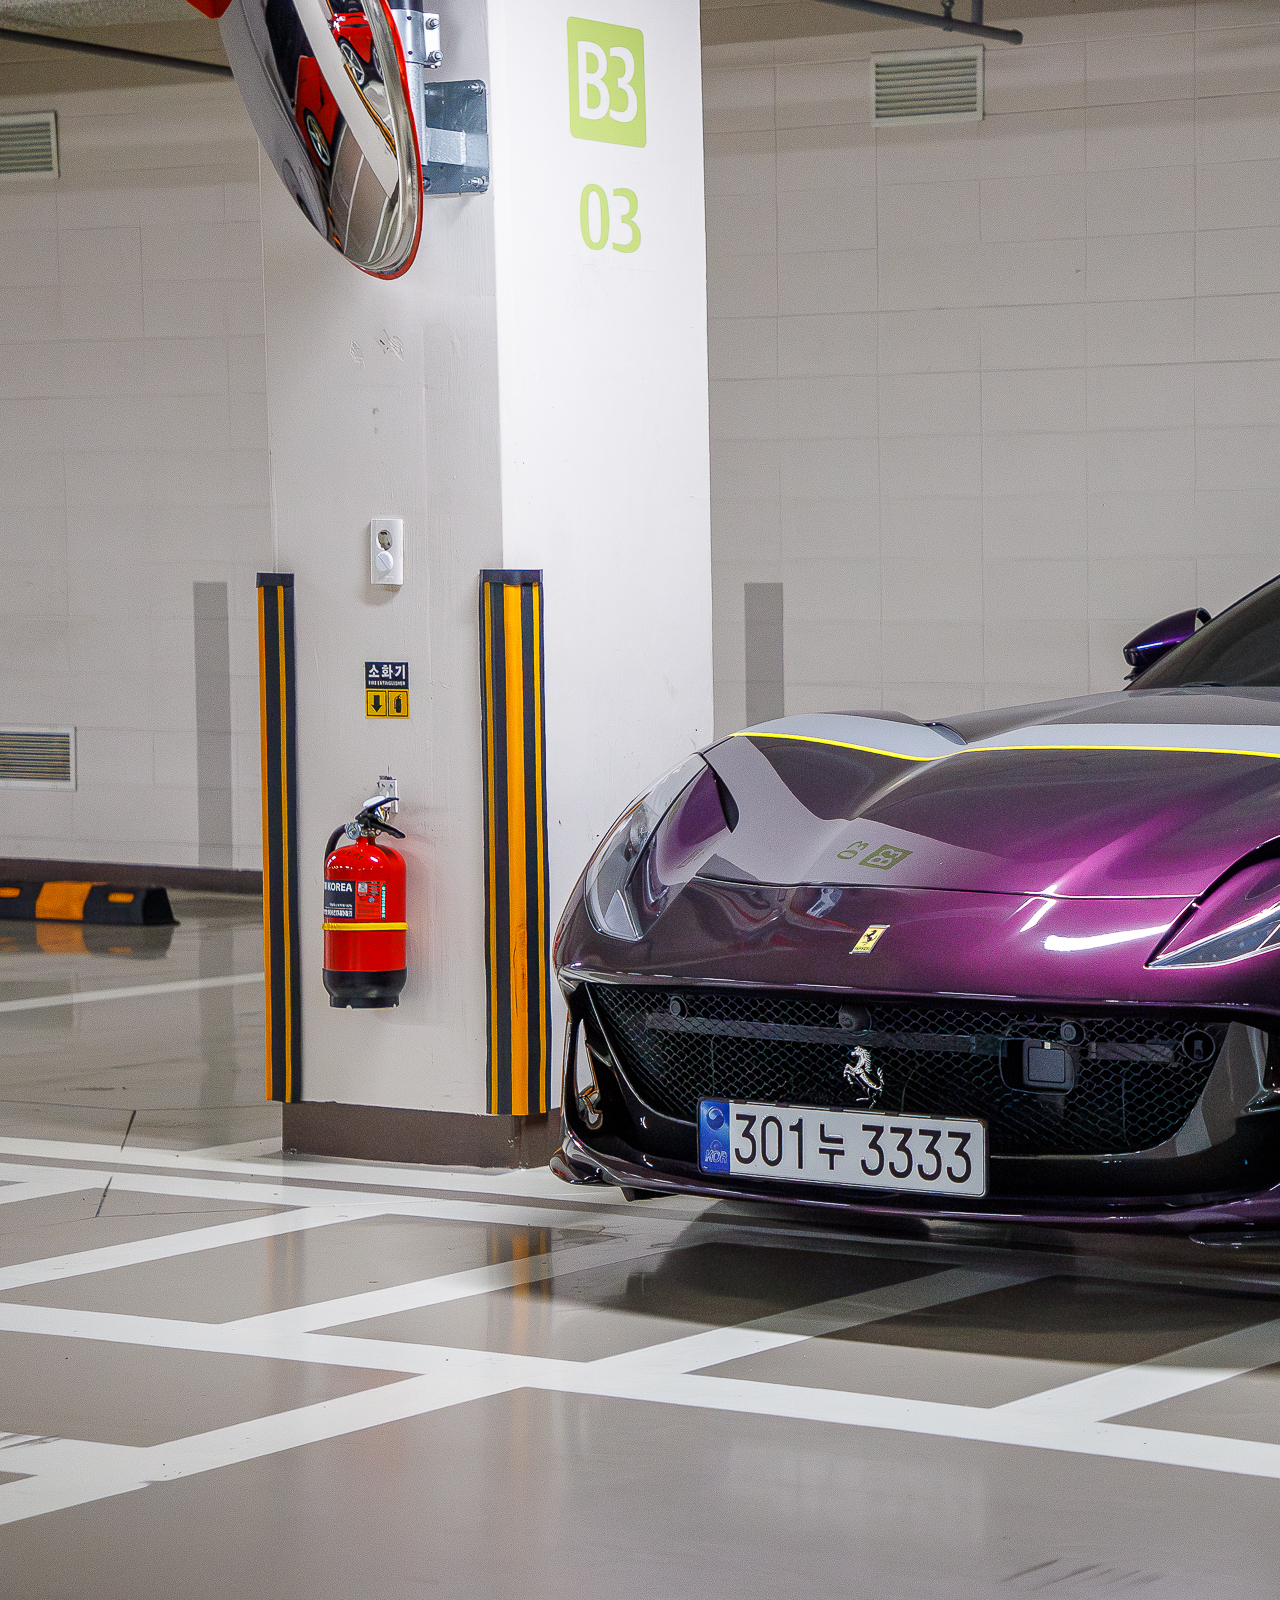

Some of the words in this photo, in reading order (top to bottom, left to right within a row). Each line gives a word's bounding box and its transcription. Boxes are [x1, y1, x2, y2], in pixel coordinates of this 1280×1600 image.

[577, 41, 638, 123] B3
[580, 183, 641, 253] 03
[368, 664, 406, 679] 소화기
[327, 882, 353, 892] KOREA
[704, 1149, 728, 1164] KOR
[734, 1113, 845, 1170] 301누
[860, 1123, 972, 1184] 3333
